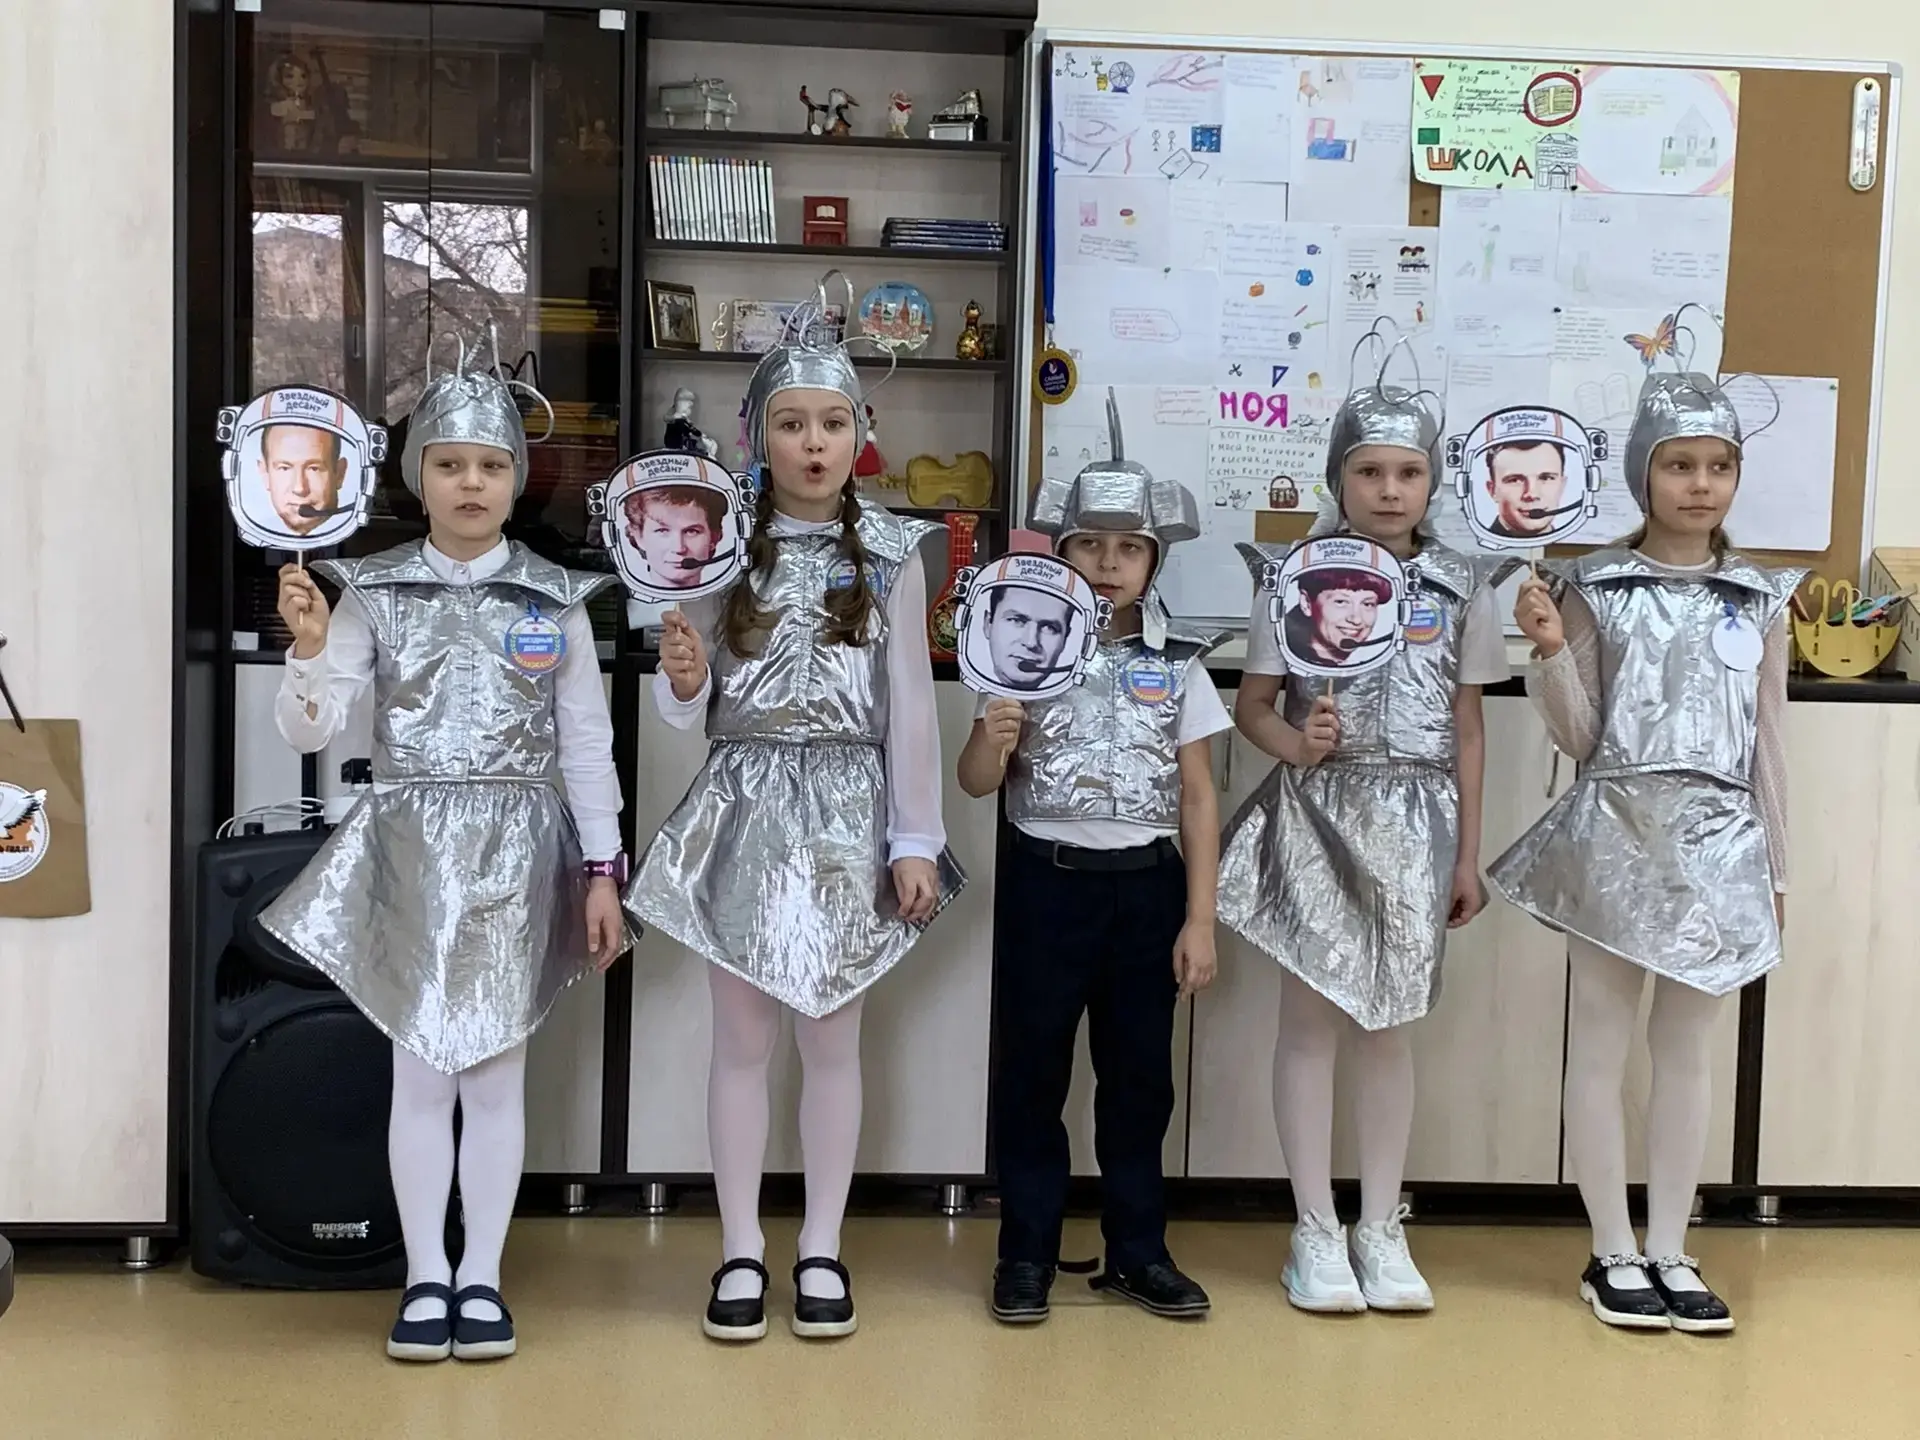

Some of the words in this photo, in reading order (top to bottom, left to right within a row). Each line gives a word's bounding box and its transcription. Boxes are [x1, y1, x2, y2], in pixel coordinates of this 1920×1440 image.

[1426, 146, 1534, 179] ШКОЛА
[286, 401, 322, 413] десант
[1219, 391, 1288, 429] МОЯ
[637, 457, 690, 471] Звездный
[647, 465, 683, 477] десант
[1020, 567, 1055, 580] десант
